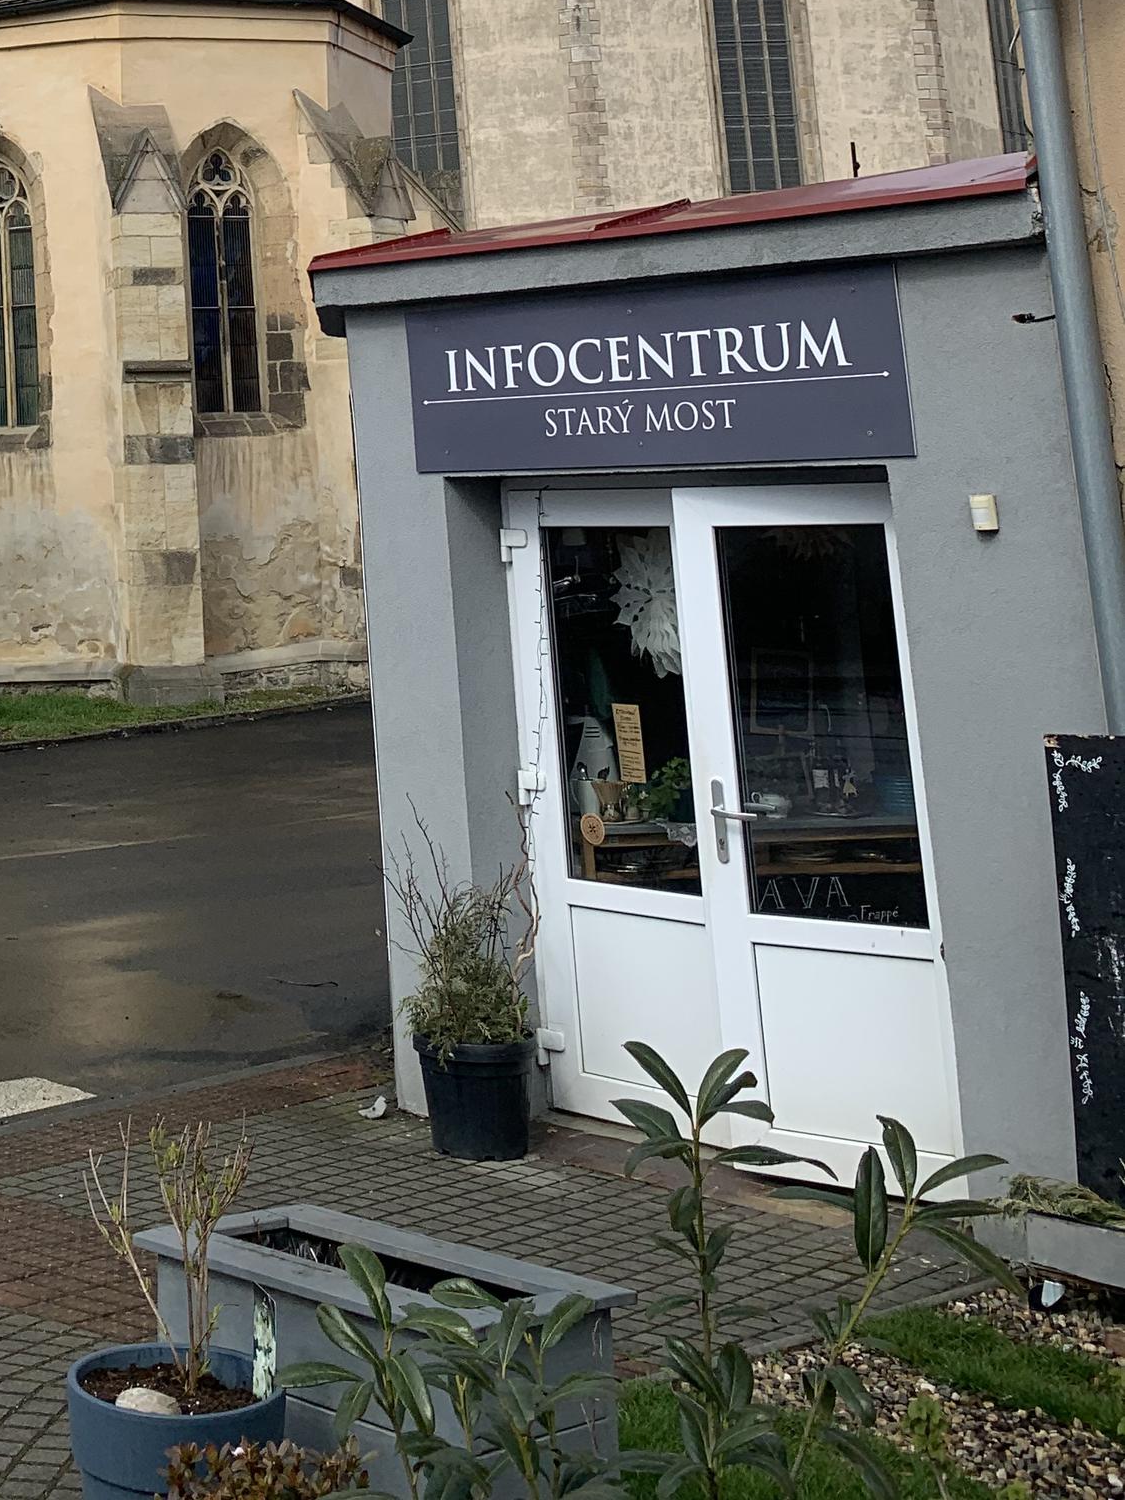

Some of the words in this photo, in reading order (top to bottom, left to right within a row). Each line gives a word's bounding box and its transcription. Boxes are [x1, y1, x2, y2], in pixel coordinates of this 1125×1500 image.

[445, 317, 852, 393] INFOCENTRUM
[544, 399, 635, 437] STARÝ
[644, 399, 736, 433] MOST
[758, 876, 852, 911] ÁVA
[860, 904, 900, 923] Frappé
